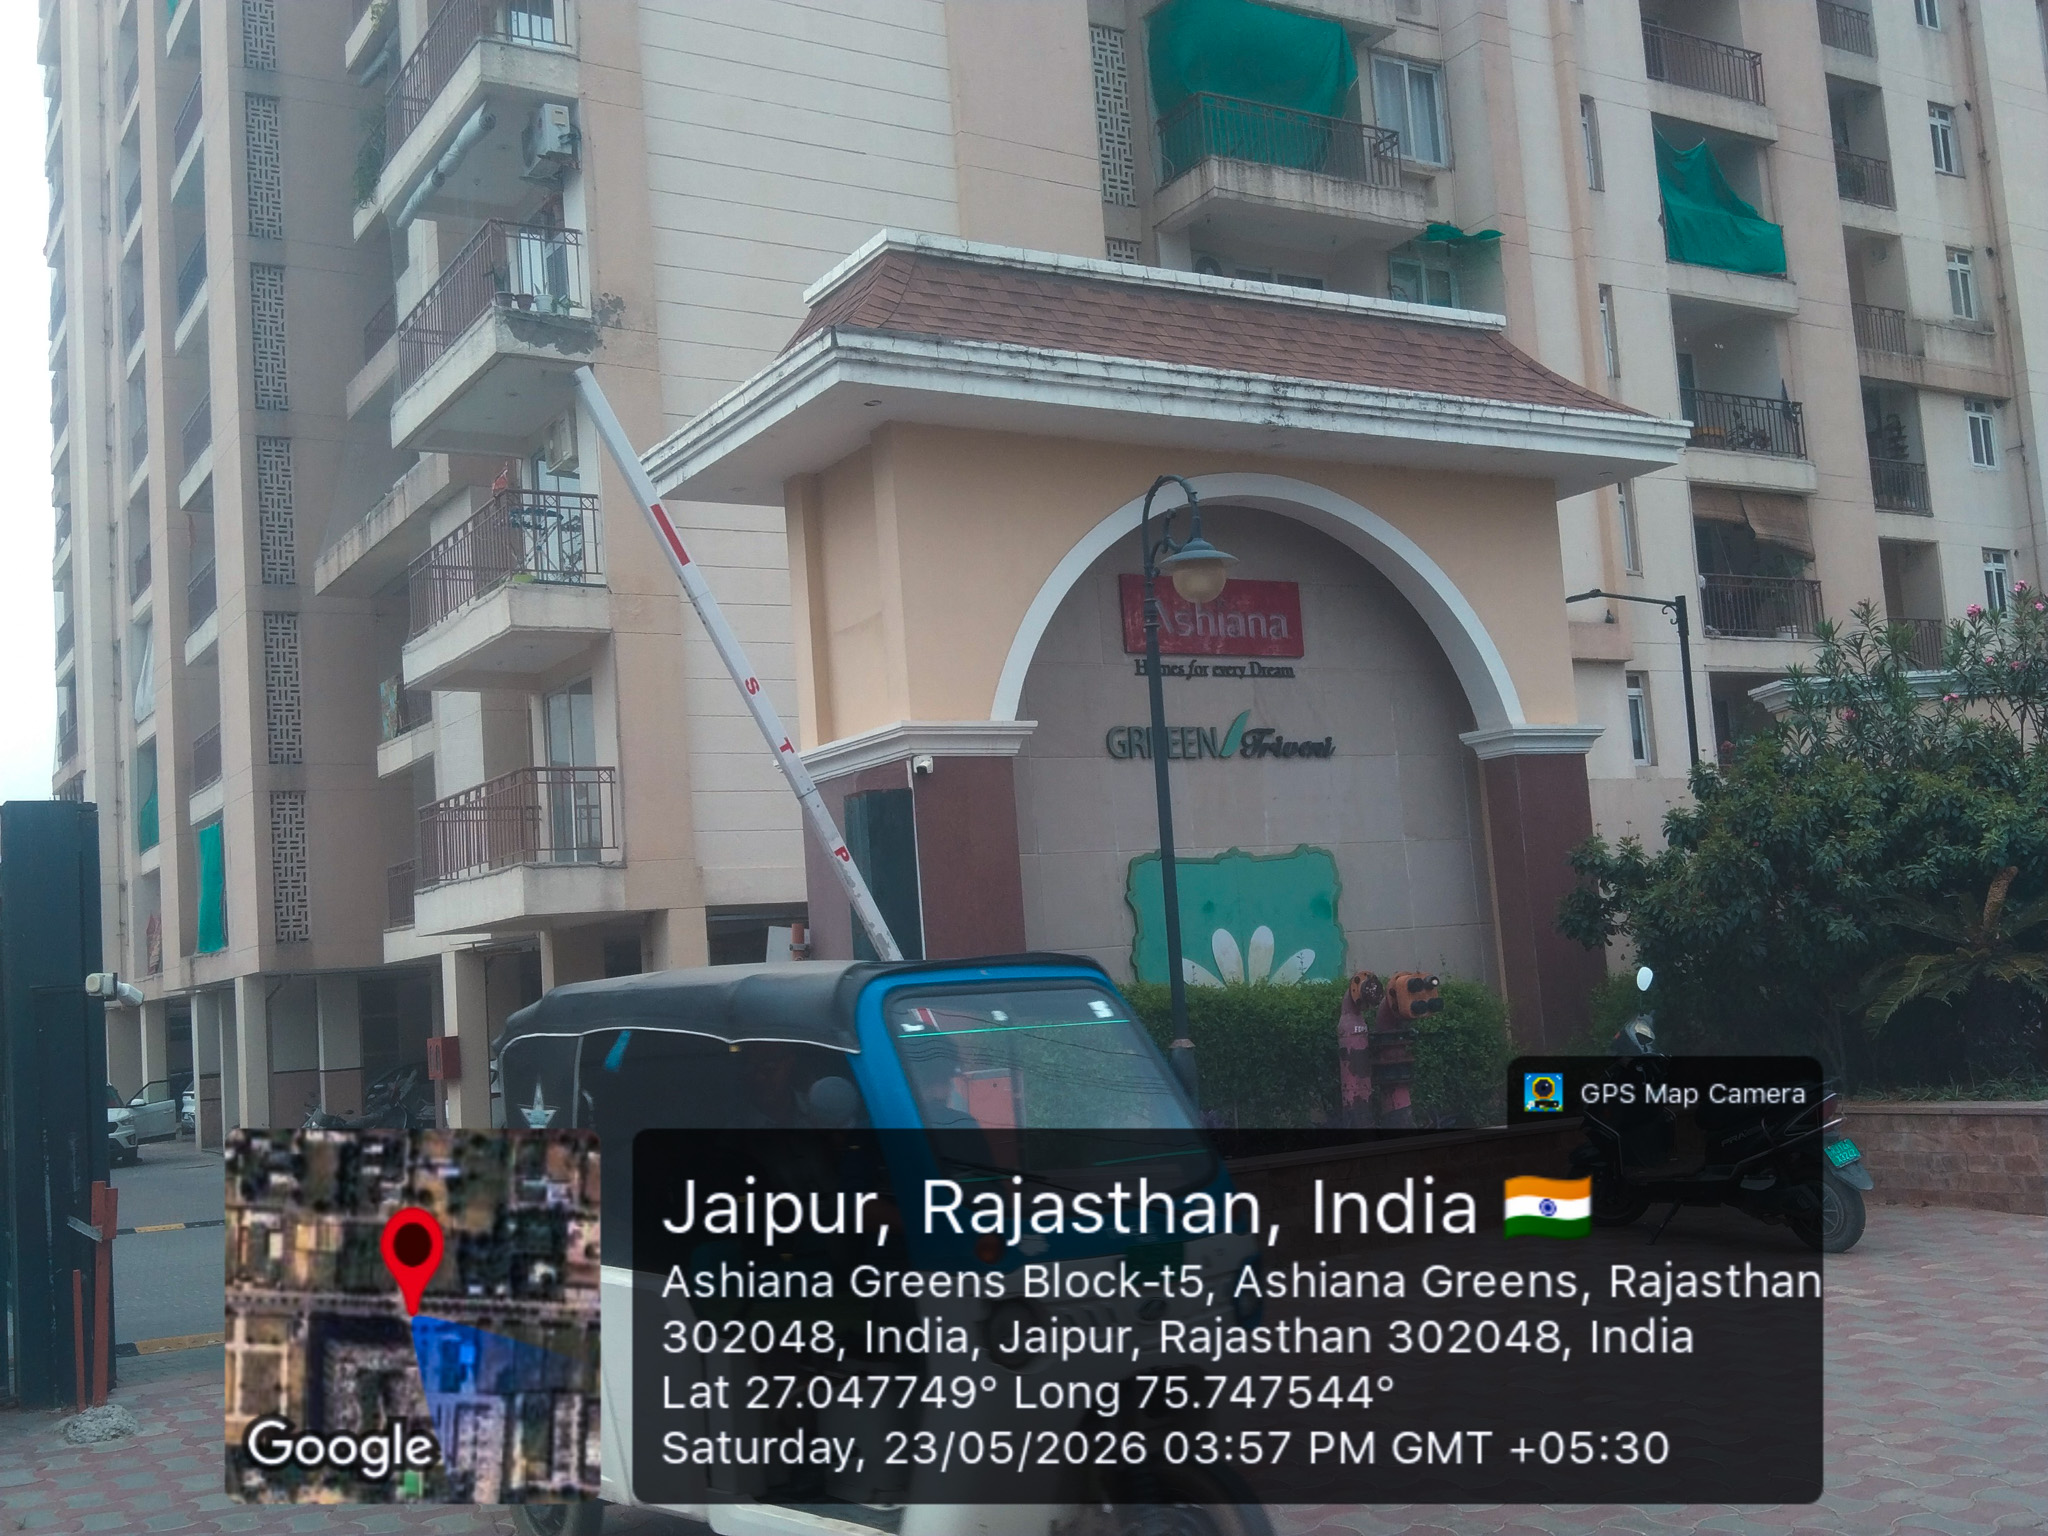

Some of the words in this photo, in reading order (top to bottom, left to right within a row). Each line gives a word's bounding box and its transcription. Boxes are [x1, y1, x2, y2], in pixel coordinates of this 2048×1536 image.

[1134, 659, 1184, 677] Hmes
[1185, 659, 1209, 680] for
[1212, 664, 1246, 679] every
[1249, 661, 1295, 678] Dream
